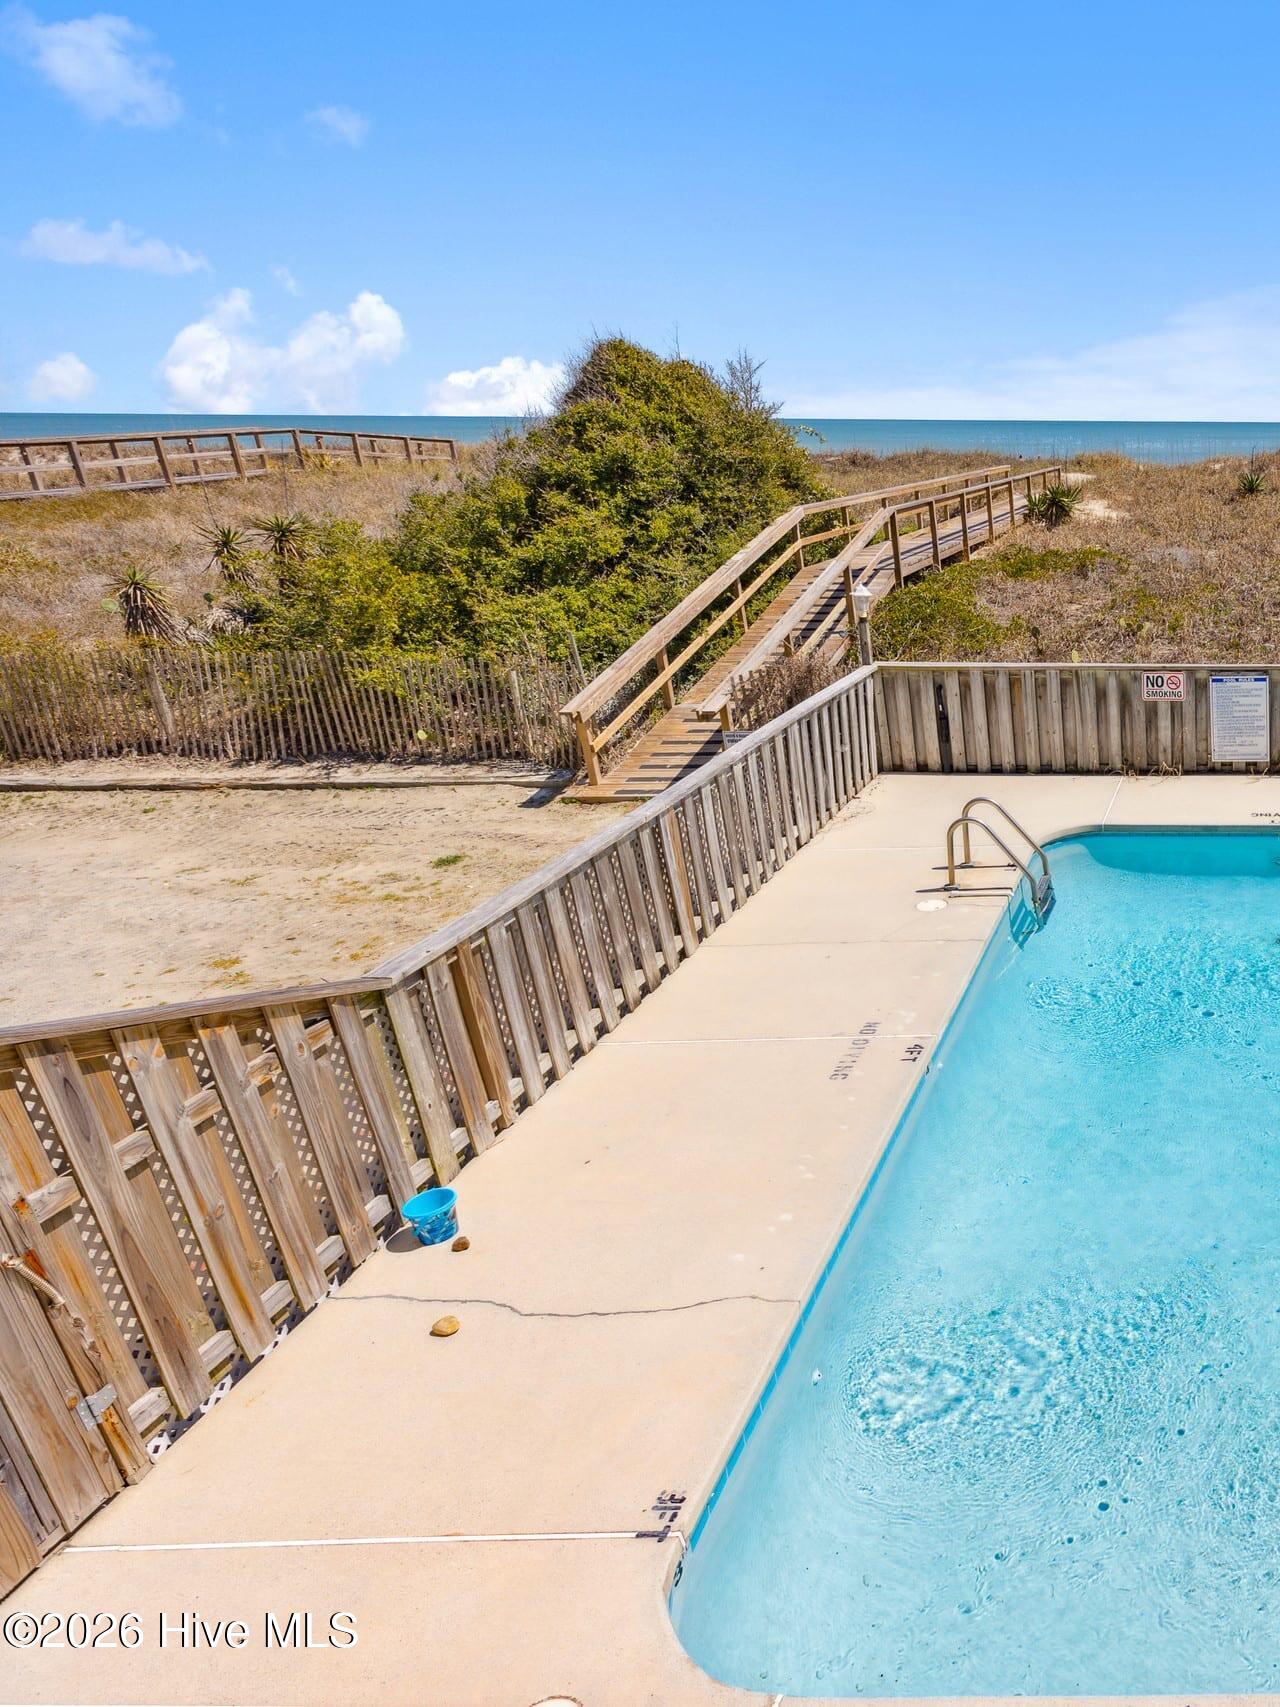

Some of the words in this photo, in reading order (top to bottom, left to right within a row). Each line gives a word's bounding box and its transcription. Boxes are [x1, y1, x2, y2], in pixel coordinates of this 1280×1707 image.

[1146, 675, 1164, 688] NO
[1146, 690, 1182, 698] SMOKING
[899, 1044, 924, 1062] 4FT
